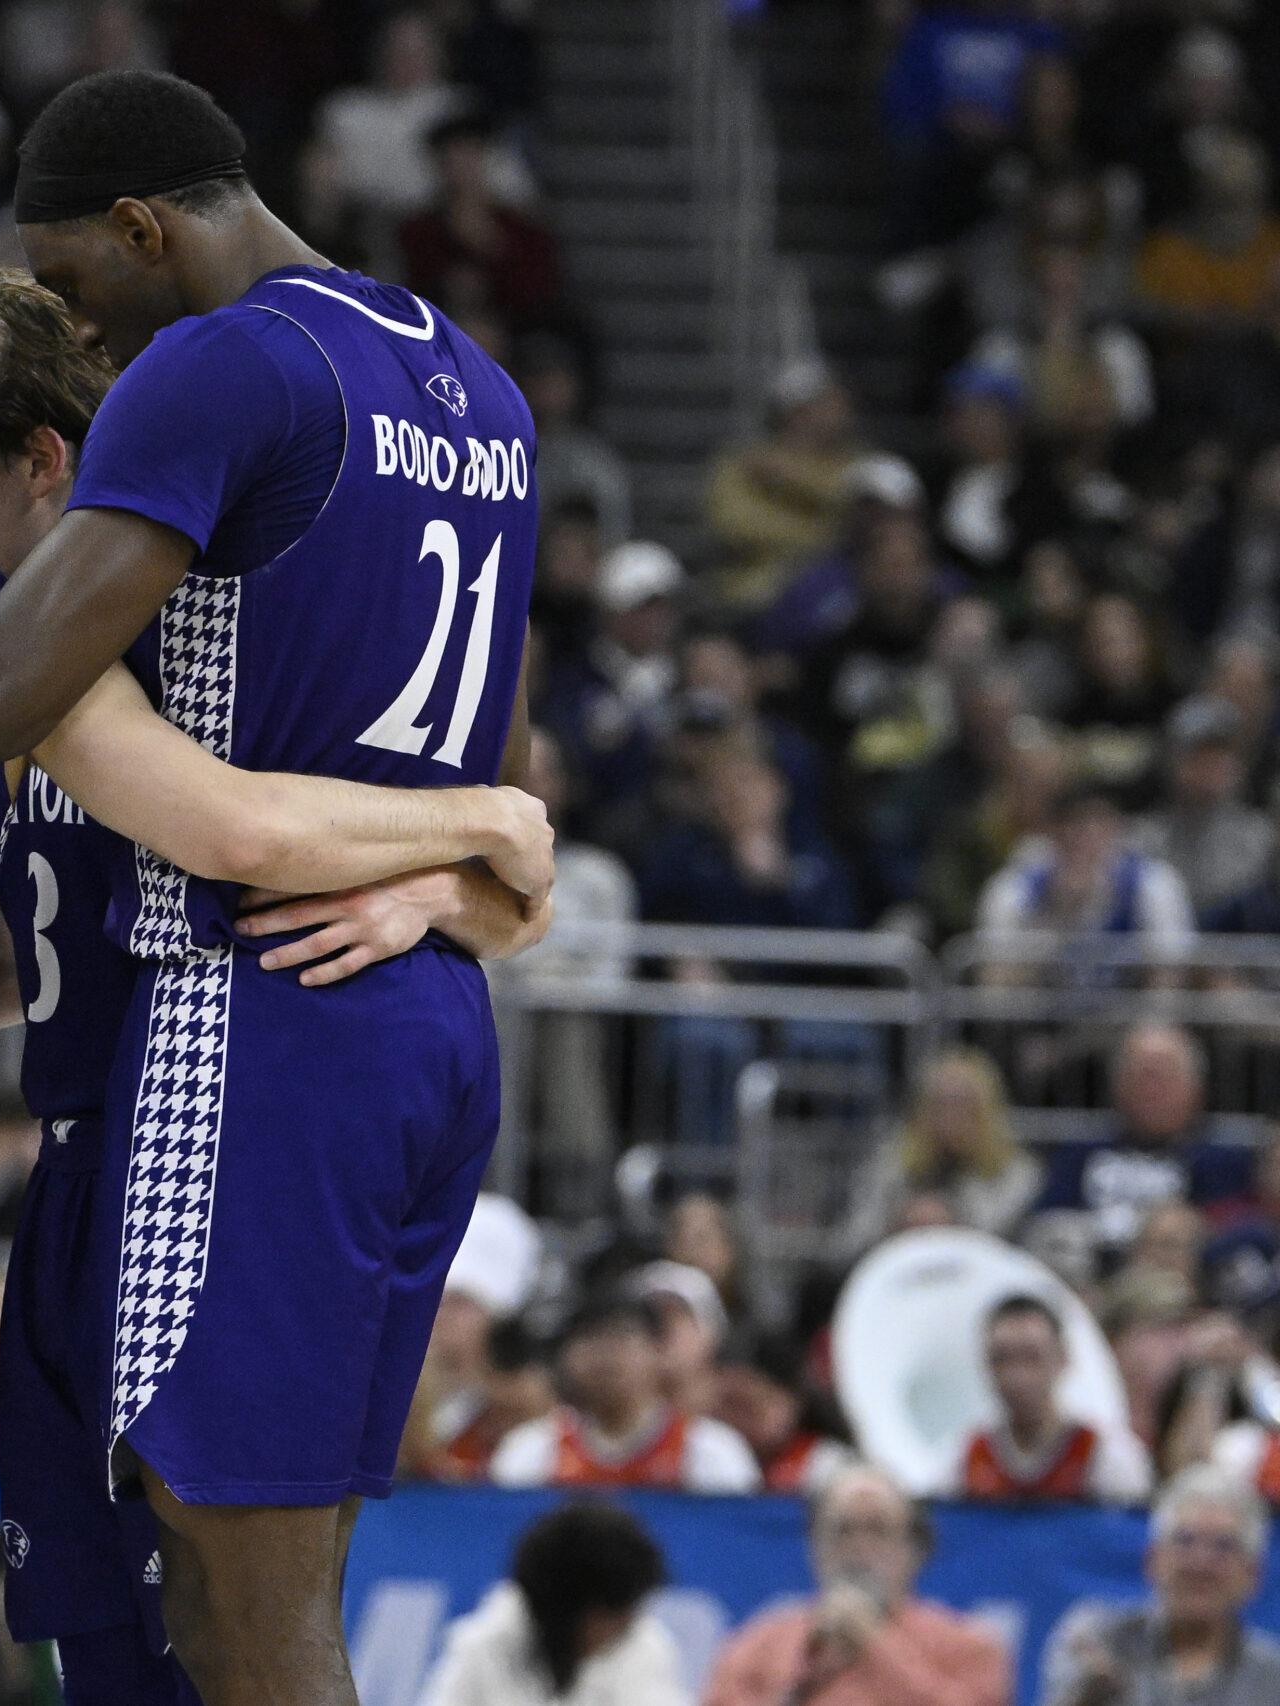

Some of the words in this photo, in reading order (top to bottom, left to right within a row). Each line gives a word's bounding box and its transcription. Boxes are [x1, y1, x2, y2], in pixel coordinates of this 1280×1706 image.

[370, 414, 458, 492] BODO
[354, 519, 503, 769] 21
[27, 851, 62, 1023] 3
